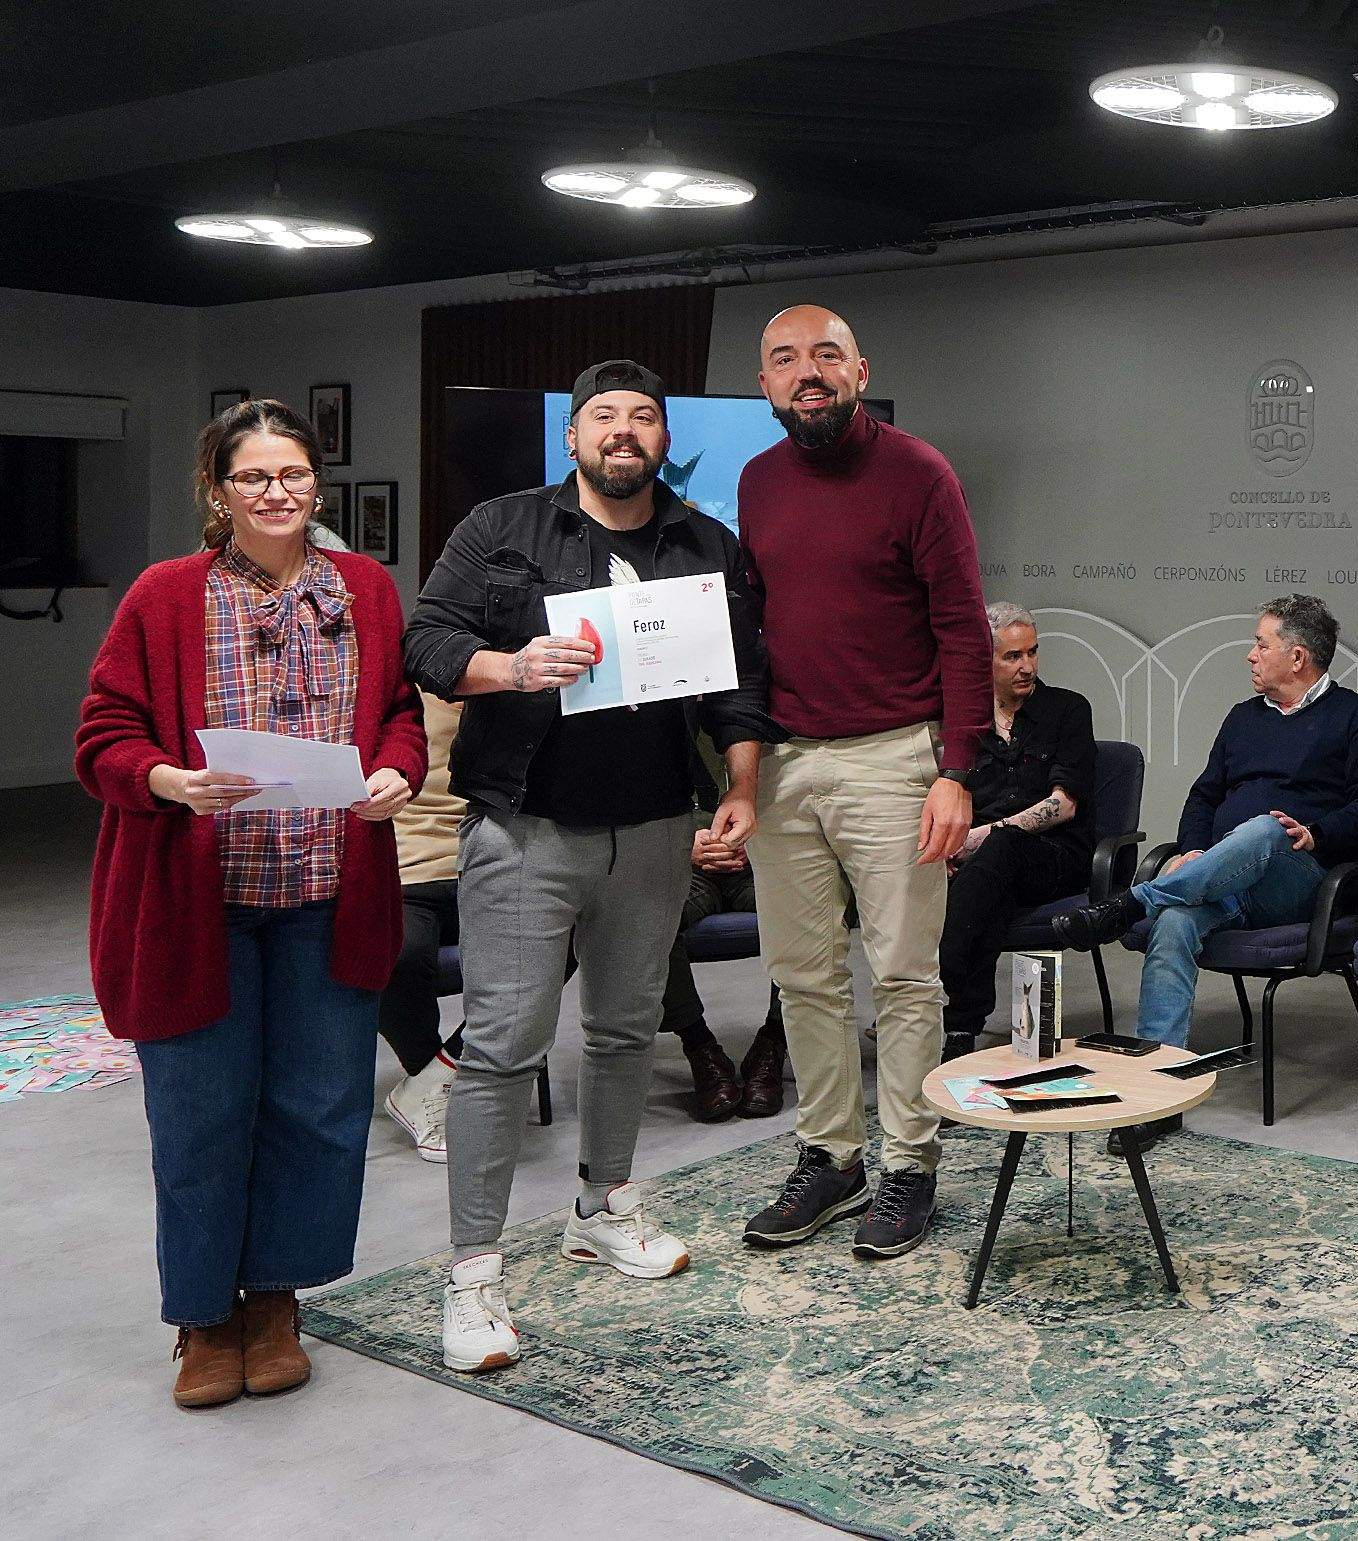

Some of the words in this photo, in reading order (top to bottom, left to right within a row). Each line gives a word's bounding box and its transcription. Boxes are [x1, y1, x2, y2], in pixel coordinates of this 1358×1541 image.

[1230, 491, 1305, 504] CONCELLO
[1308, 491, 1331, 504] DE
[1208, 511, 1353, 534] PONTEVEDRA
[1022, 564, 1057, 578] BORA
[1072, 562, 1137, 580] CAMPAÑÓ
[1152, 564, 1247, 582] CERPONZÓNS
[1265, 566, 1307, 584] LÉREZ
[633, 619, 666, 633] Feroz
